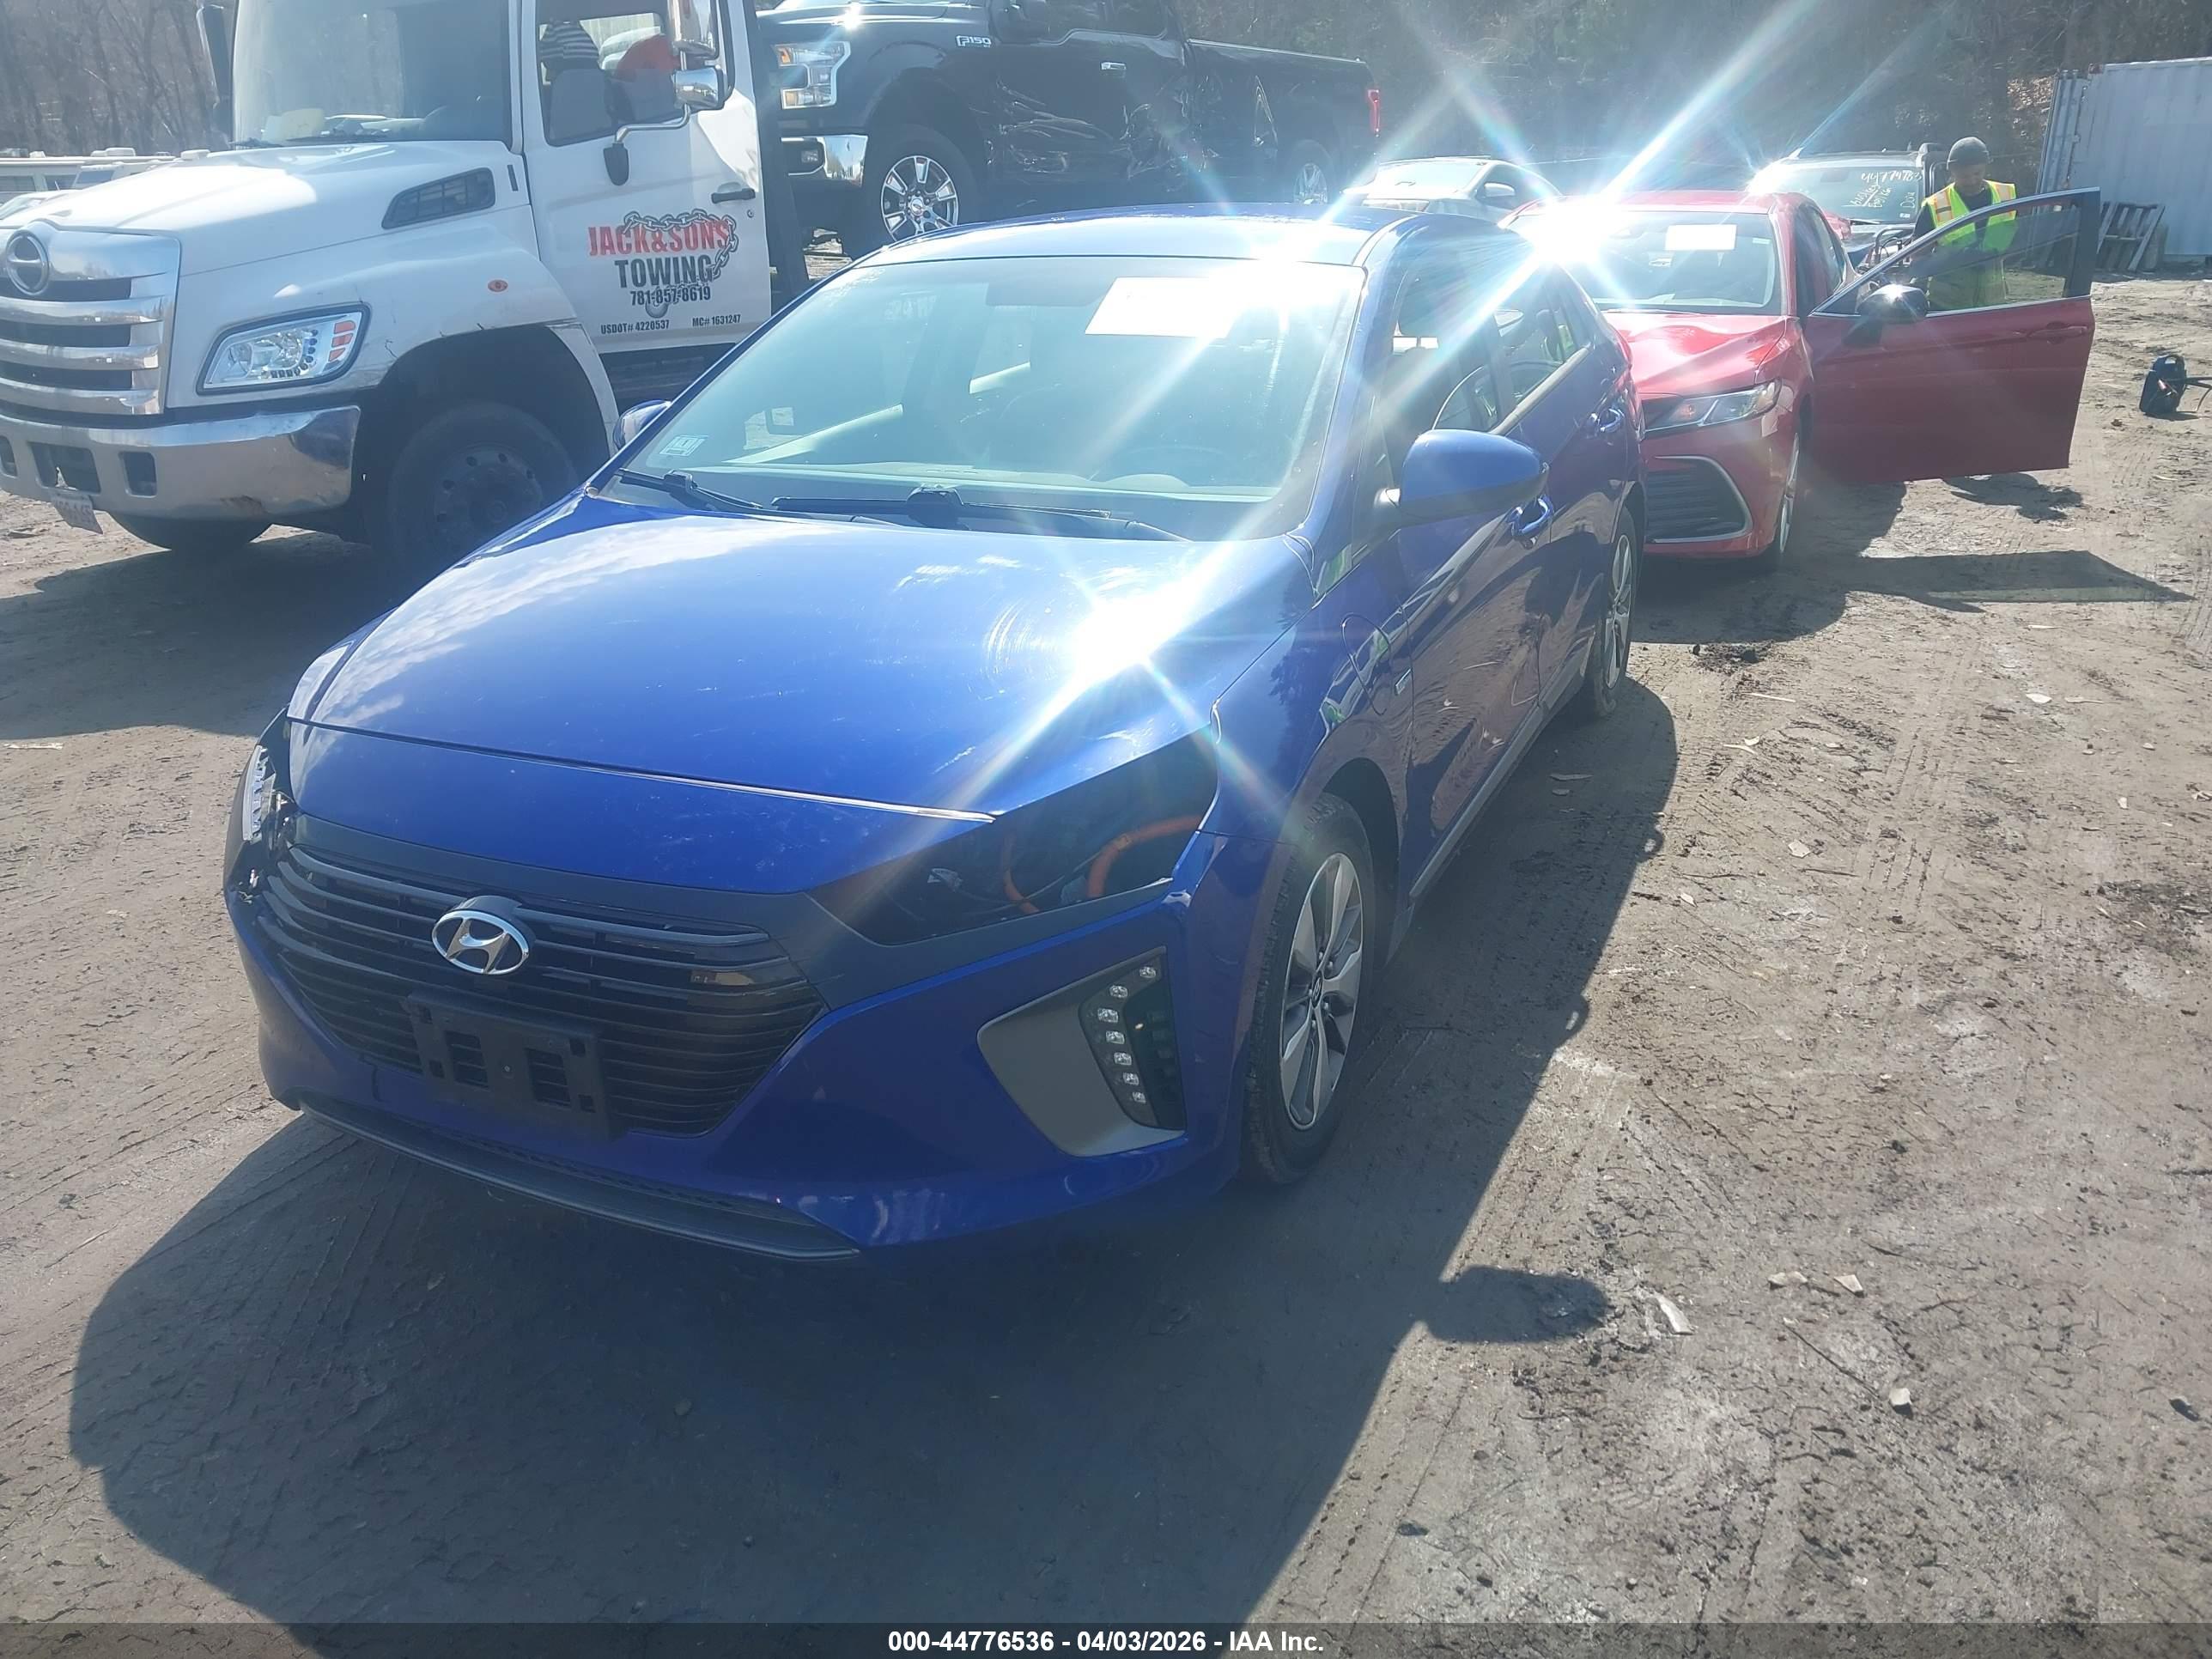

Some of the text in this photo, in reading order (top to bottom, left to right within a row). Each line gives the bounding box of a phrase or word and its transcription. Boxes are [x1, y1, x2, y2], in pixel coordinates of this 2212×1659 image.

[588, 219, 730, 257] JACK&SONS
[614, 254, 714, 289] TOWING
[629, 285, 712, 307] 781-857-8619
[600, 319, 670, 335] USDOT# 4220537
[692, 314, 741, 327] MC# 1631247
